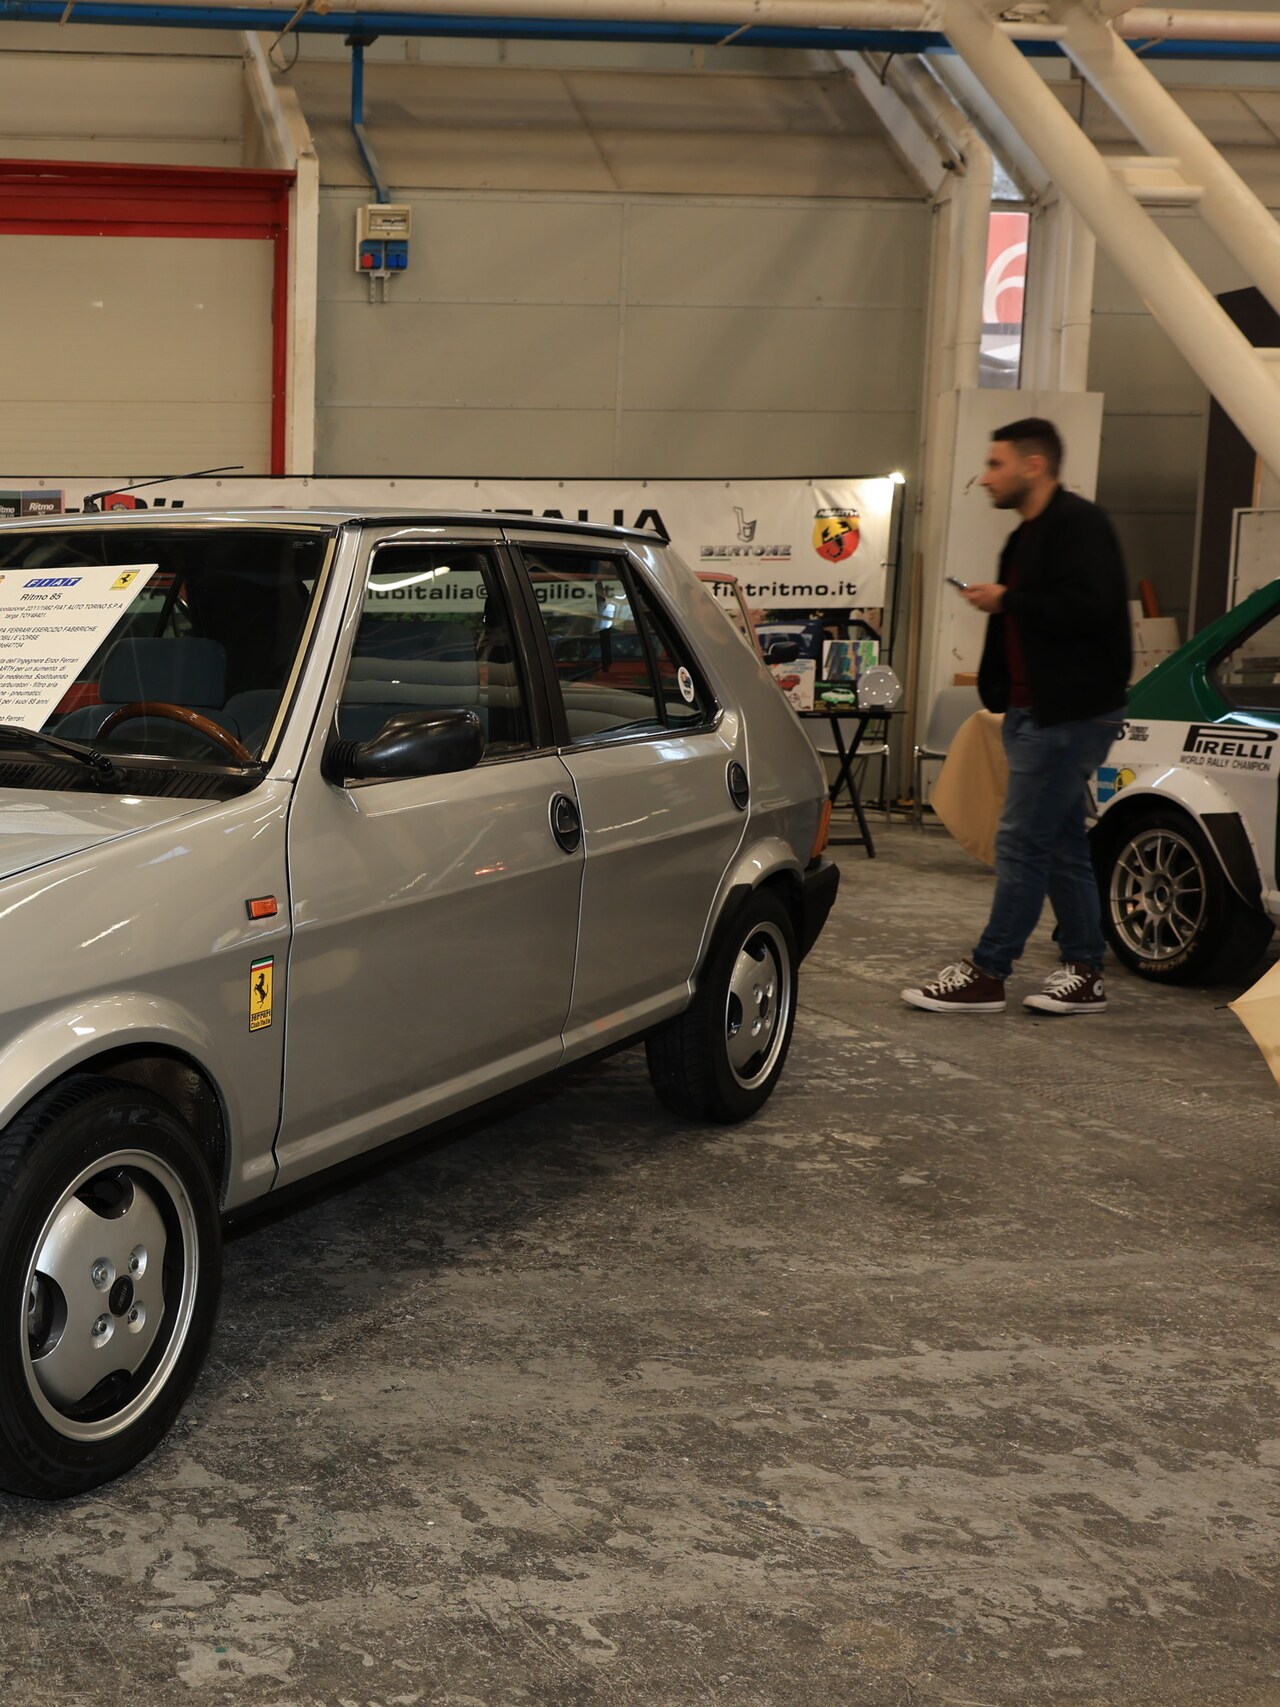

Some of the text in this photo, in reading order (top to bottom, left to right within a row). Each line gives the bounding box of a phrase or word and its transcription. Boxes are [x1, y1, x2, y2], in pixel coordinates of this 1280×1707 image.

[28, 502, 54, 511] Ritmo
[700, 545, 792, 557] BERTONE
[29, 579, 77, 587] FIAT
[49, 592, 63, 600] 85
[1183, 724, 1278, 759] PIRELLI
[1180, 755, 1272, 772] WORLD RALLY CHAMPION
[251, 1010, 271, 1022] Ferrari
[250, 1021, 260, 1029] Club
